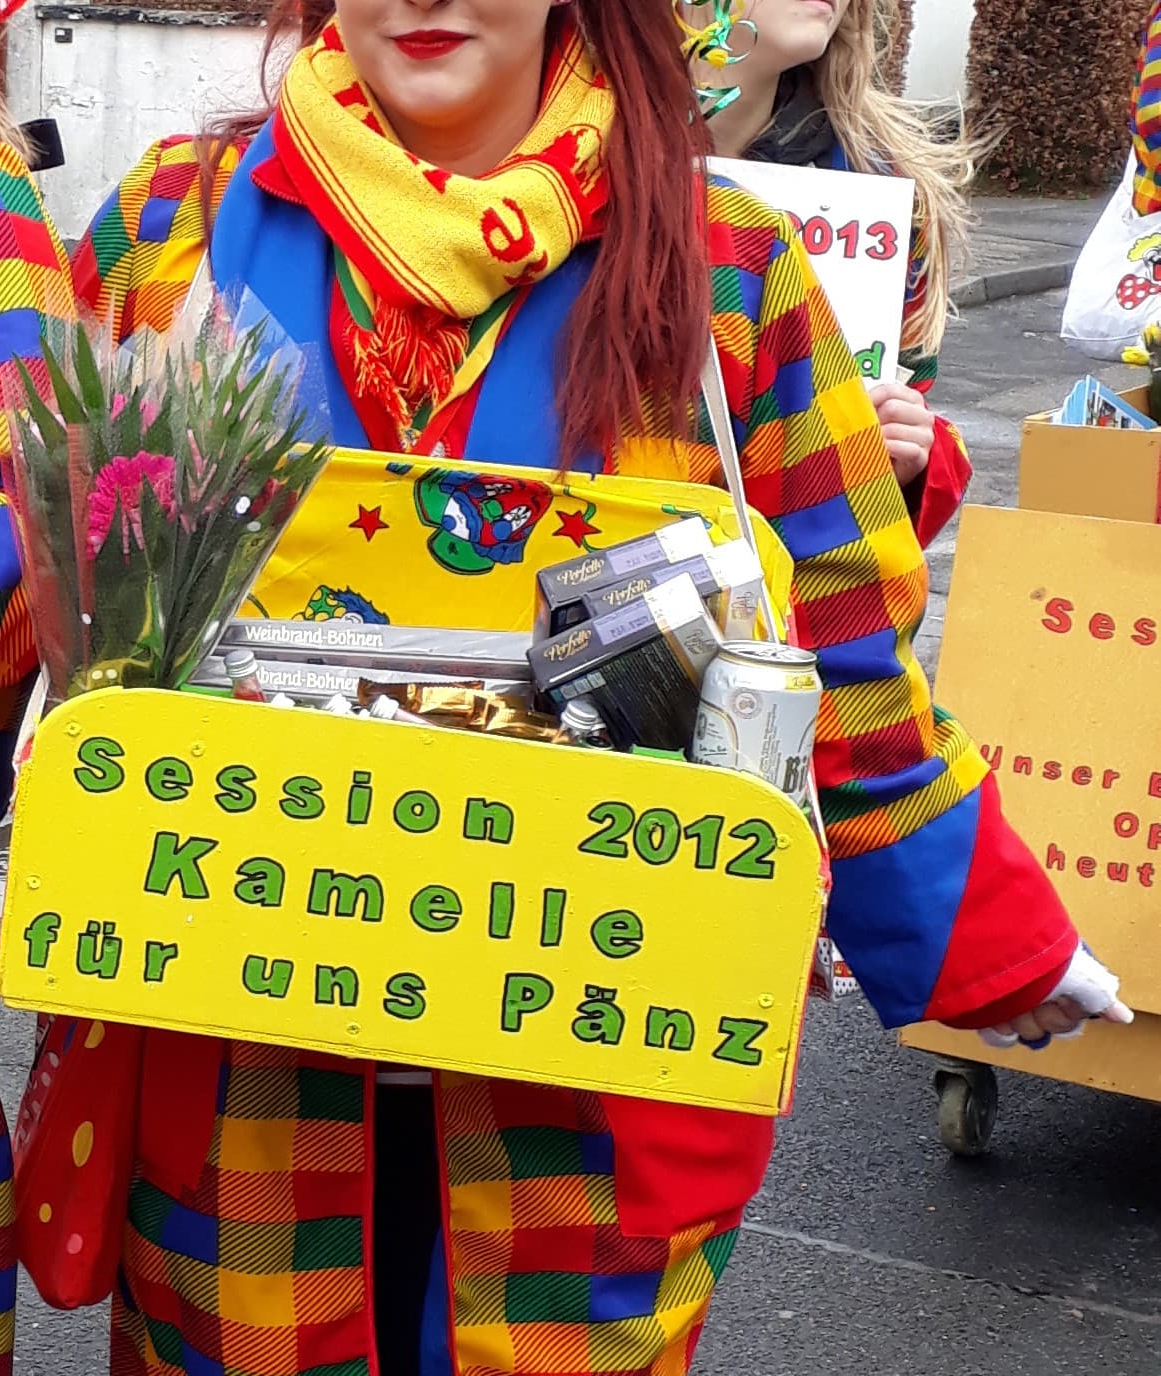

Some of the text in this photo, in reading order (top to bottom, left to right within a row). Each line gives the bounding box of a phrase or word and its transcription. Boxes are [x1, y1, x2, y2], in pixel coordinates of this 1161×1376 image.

[786, 210, 898, 261] 013
[245, 625, 383, 648] Weinbrand-Bohnen
[73, 736, 778, 880] Session 2012
[143, 831, 644, 959] Kamelle
[23, 911, 769, 1066] für uns Pänz
